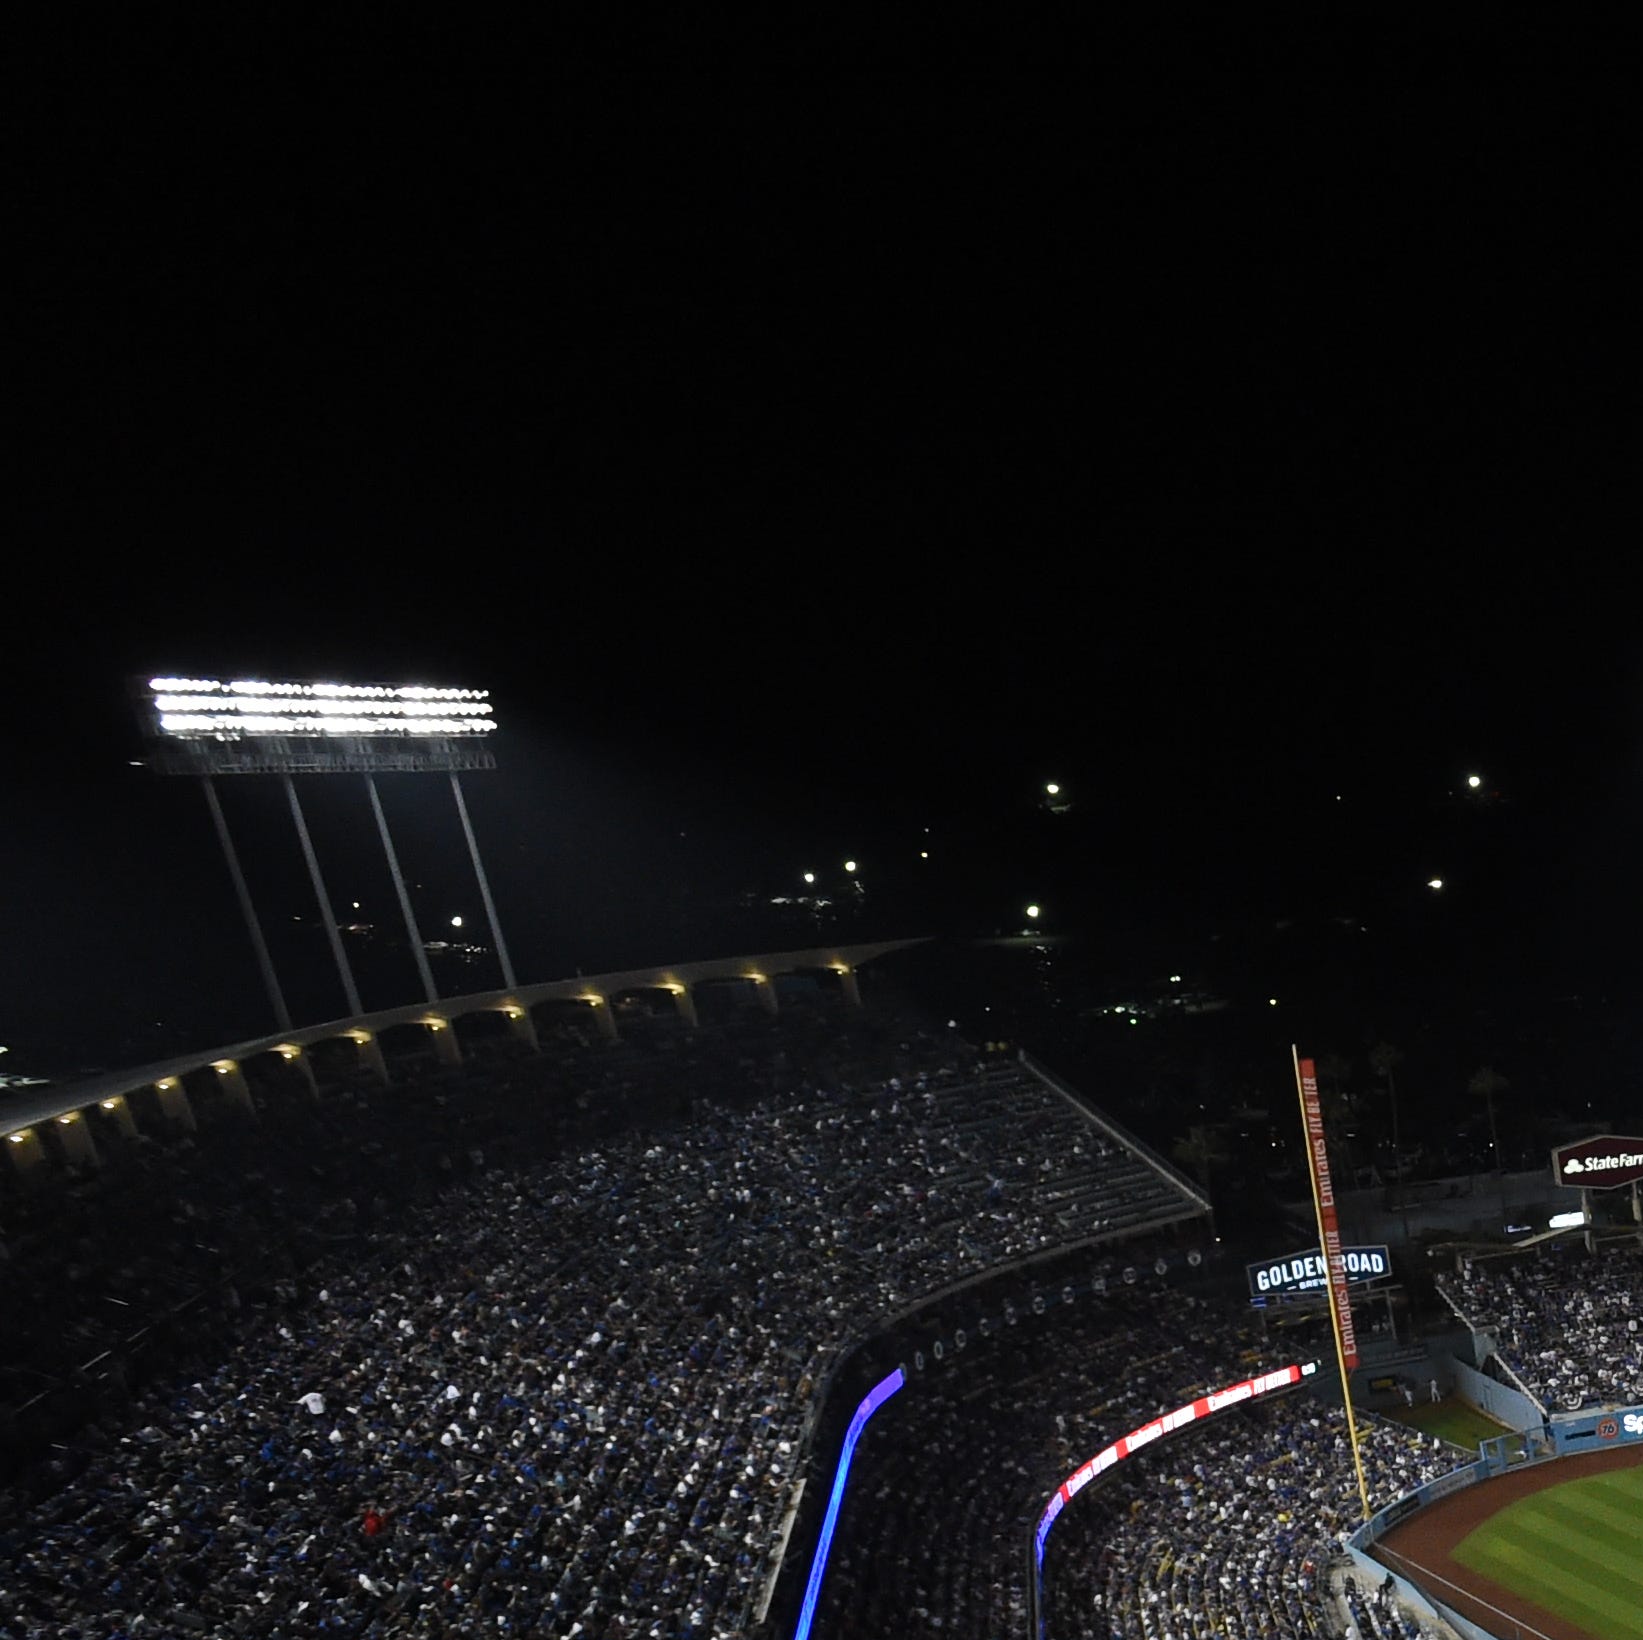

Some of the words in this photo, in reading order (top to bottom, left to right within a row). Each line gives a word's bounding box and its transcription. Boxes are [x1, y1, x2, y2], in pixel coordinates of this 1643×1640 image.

[1313, 1138, 1335, 1208] Emirates
[1338, 1289, 1357, 1355] Emirates
[1602, 1424, 1615, 1433] 76
